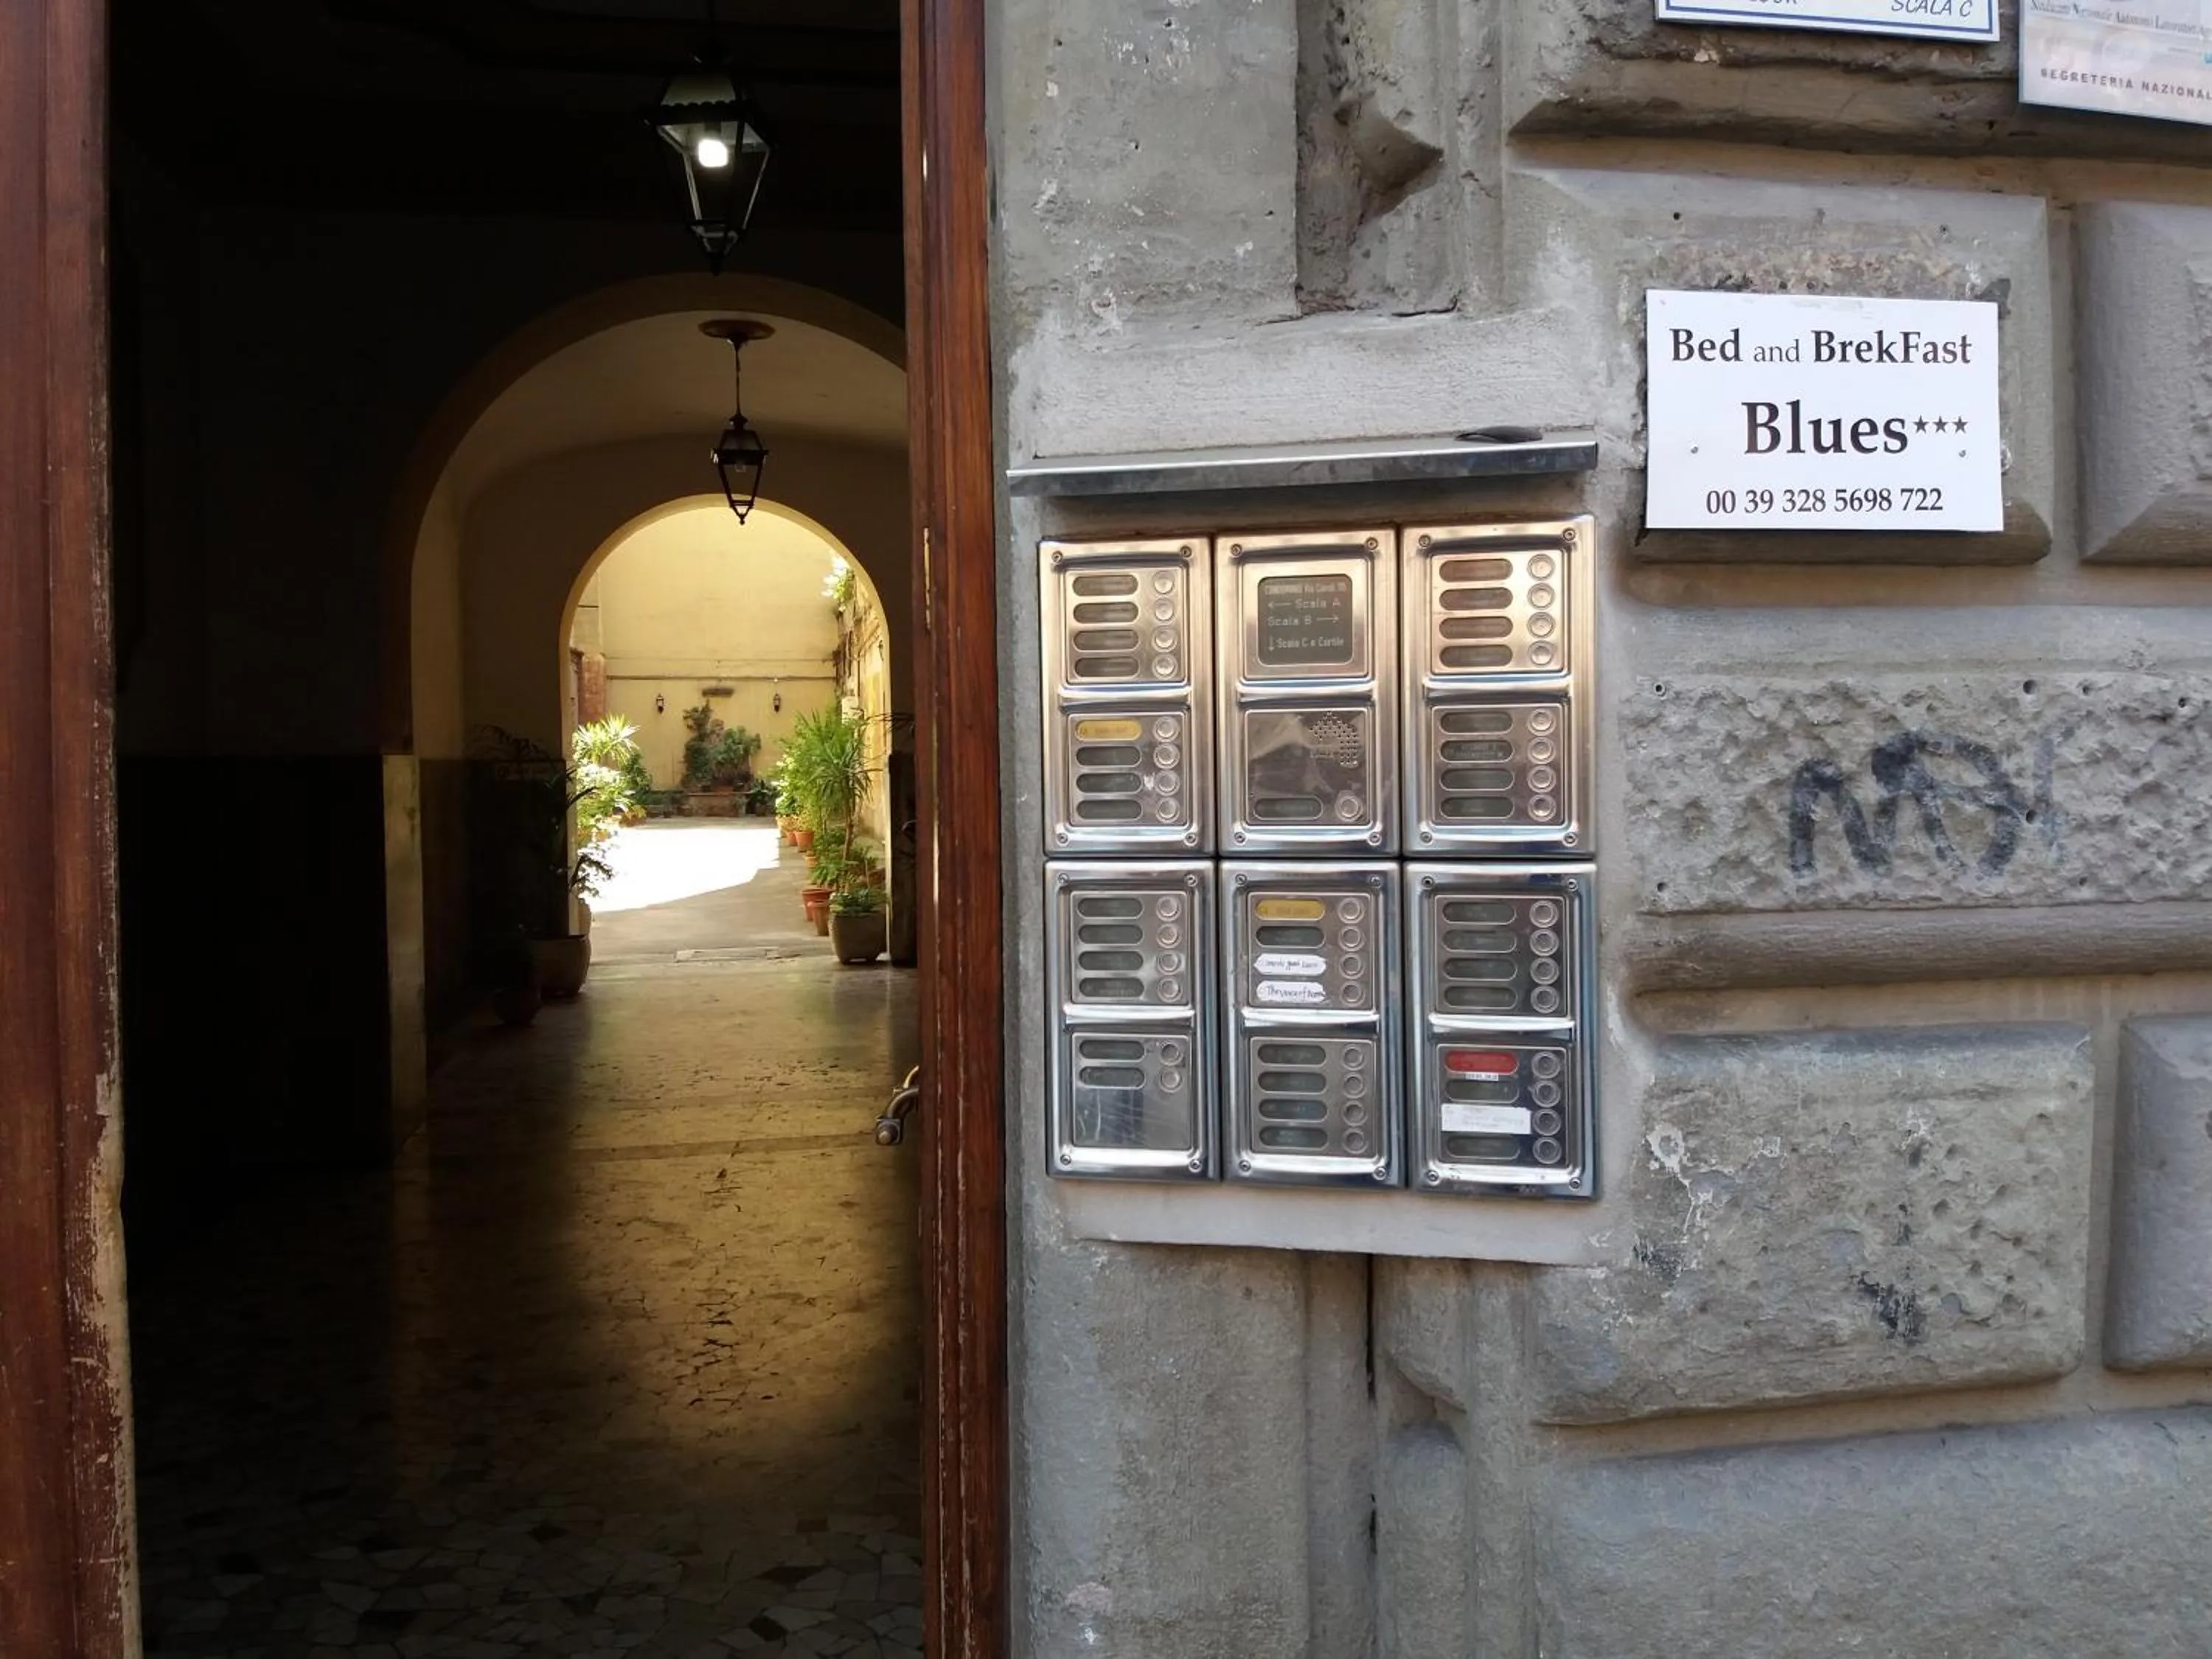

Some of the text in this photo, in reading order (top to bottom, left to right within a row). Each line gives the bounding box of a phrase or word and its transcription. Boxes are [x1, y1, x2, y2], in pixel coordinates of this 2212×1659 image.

[1891, 0, 1972, 17] SCALA C
[2040, 68, 2135, 89] SEGRETERIA
[1669, 327, 1972, 365] Bed and BrekFast
[1741, 399, 1909, 455] Blues
[1705, 487, 1944, 514] 00 39 328 5698 722
[1295, 597, 1341, 609] Scala A
[1267, 616, 1300, 627] Scala
